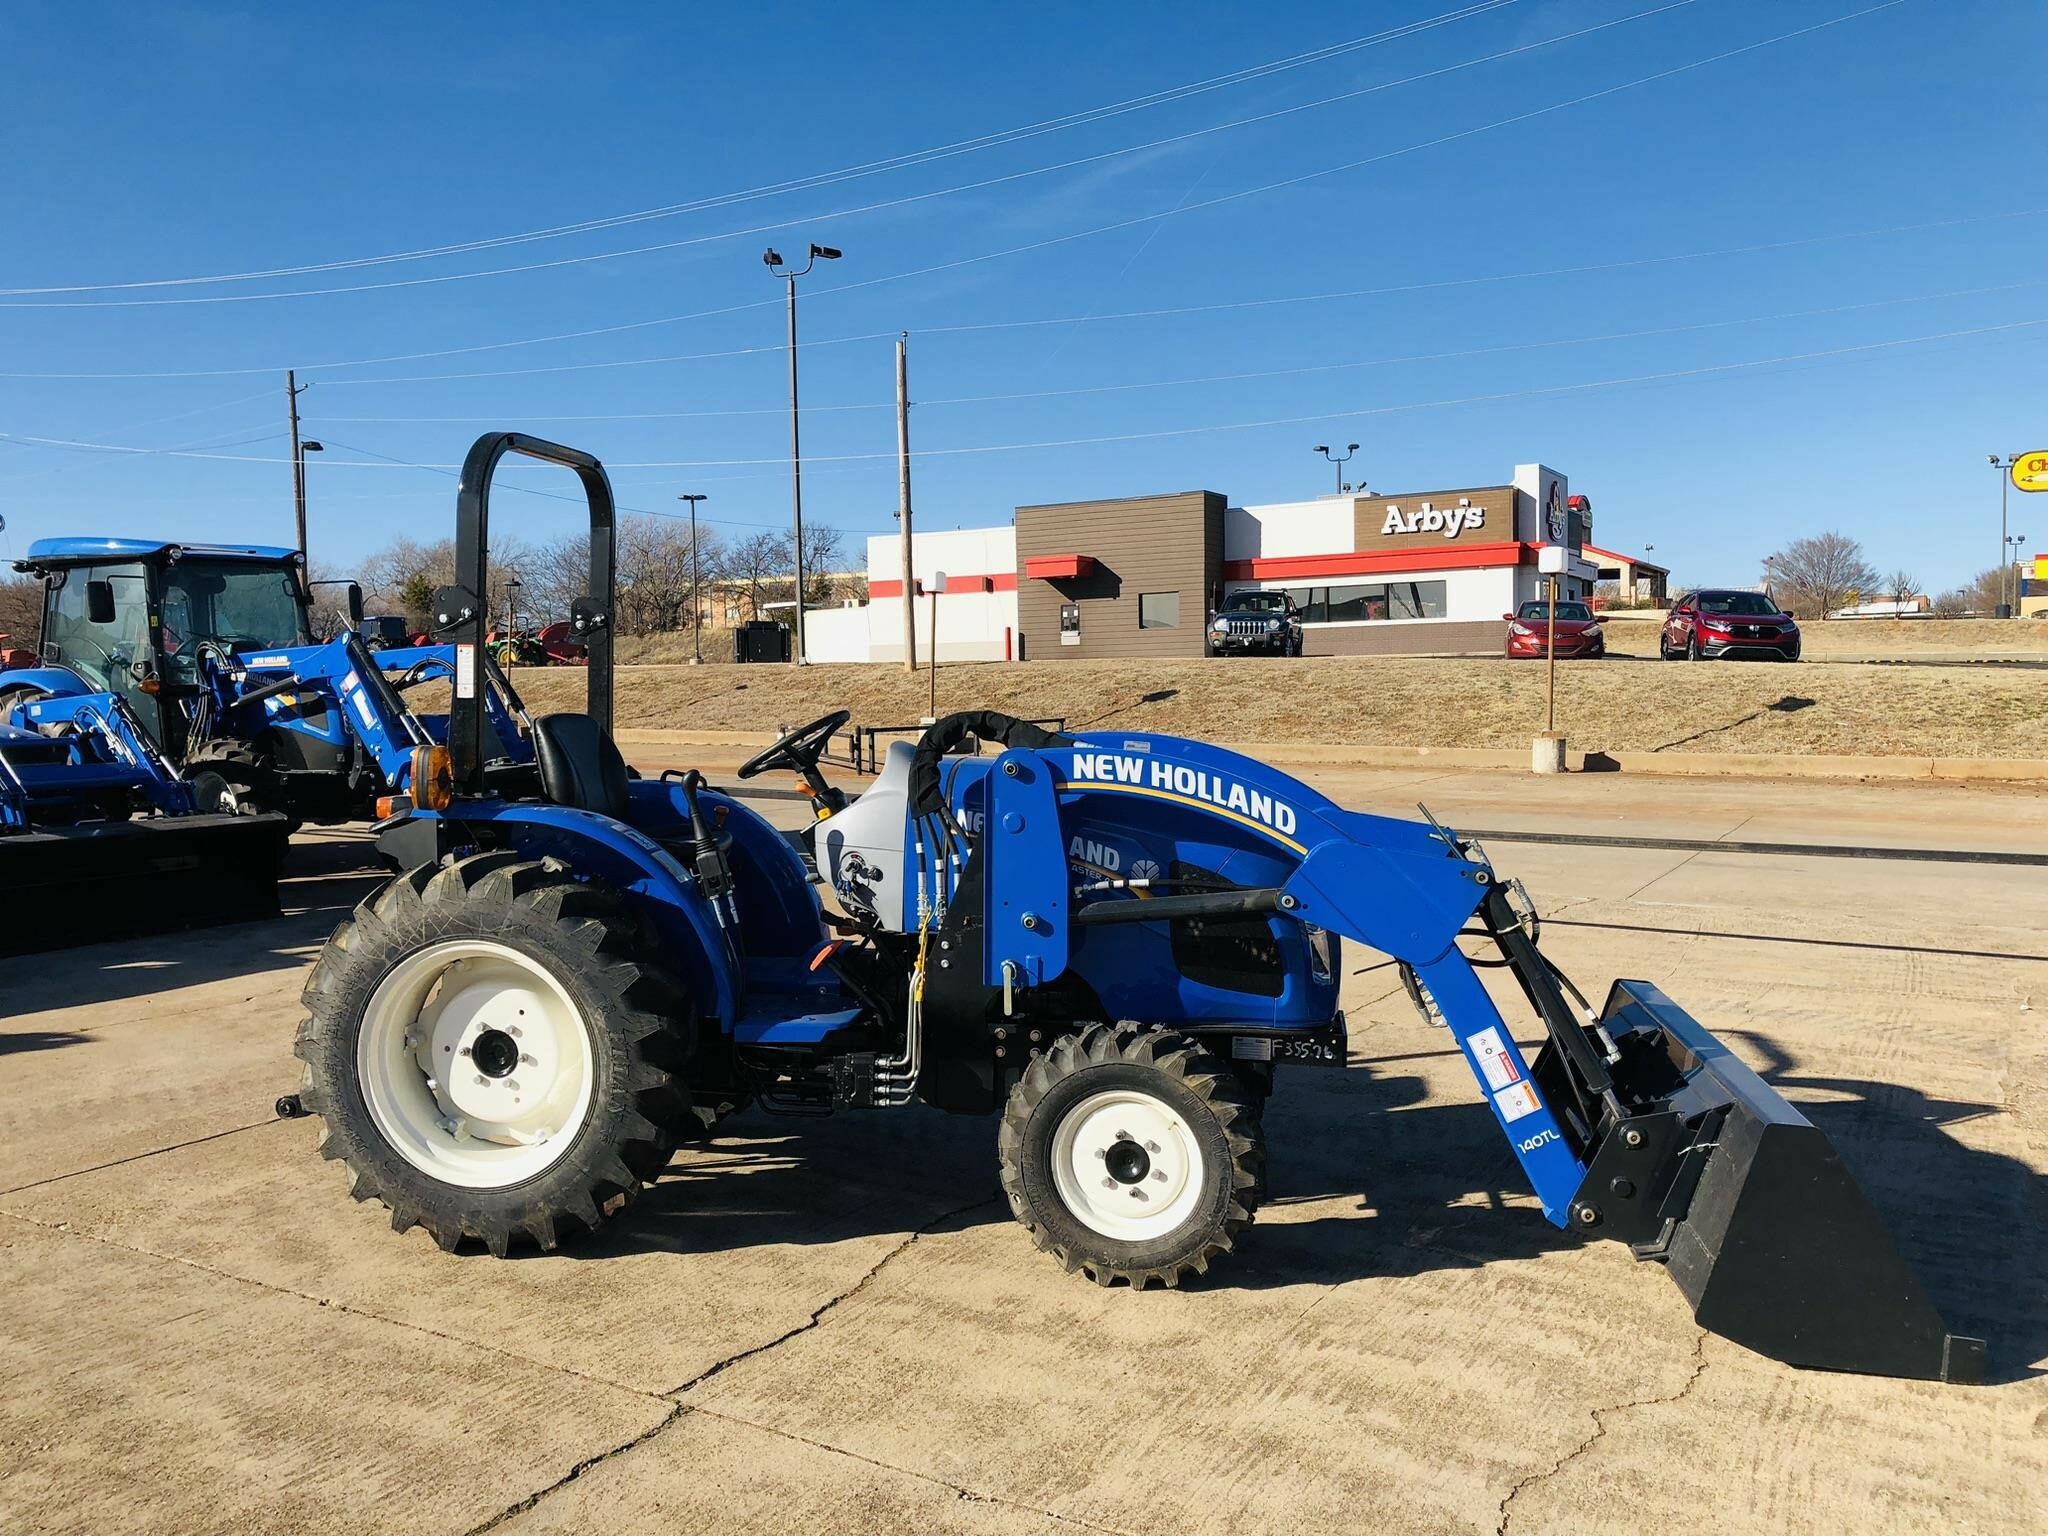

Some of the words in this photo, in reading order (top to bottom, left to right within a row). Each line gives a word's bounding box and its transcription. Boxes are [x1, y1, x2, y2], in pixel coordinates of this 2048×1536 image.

[1381, 499, 1485, 539] Arby's
[1073, 753, 1144, 785] NEW
[1150, 759, 1296, 836] HOLLAND
[1517, 1129, 1560, 1154] 140TL
